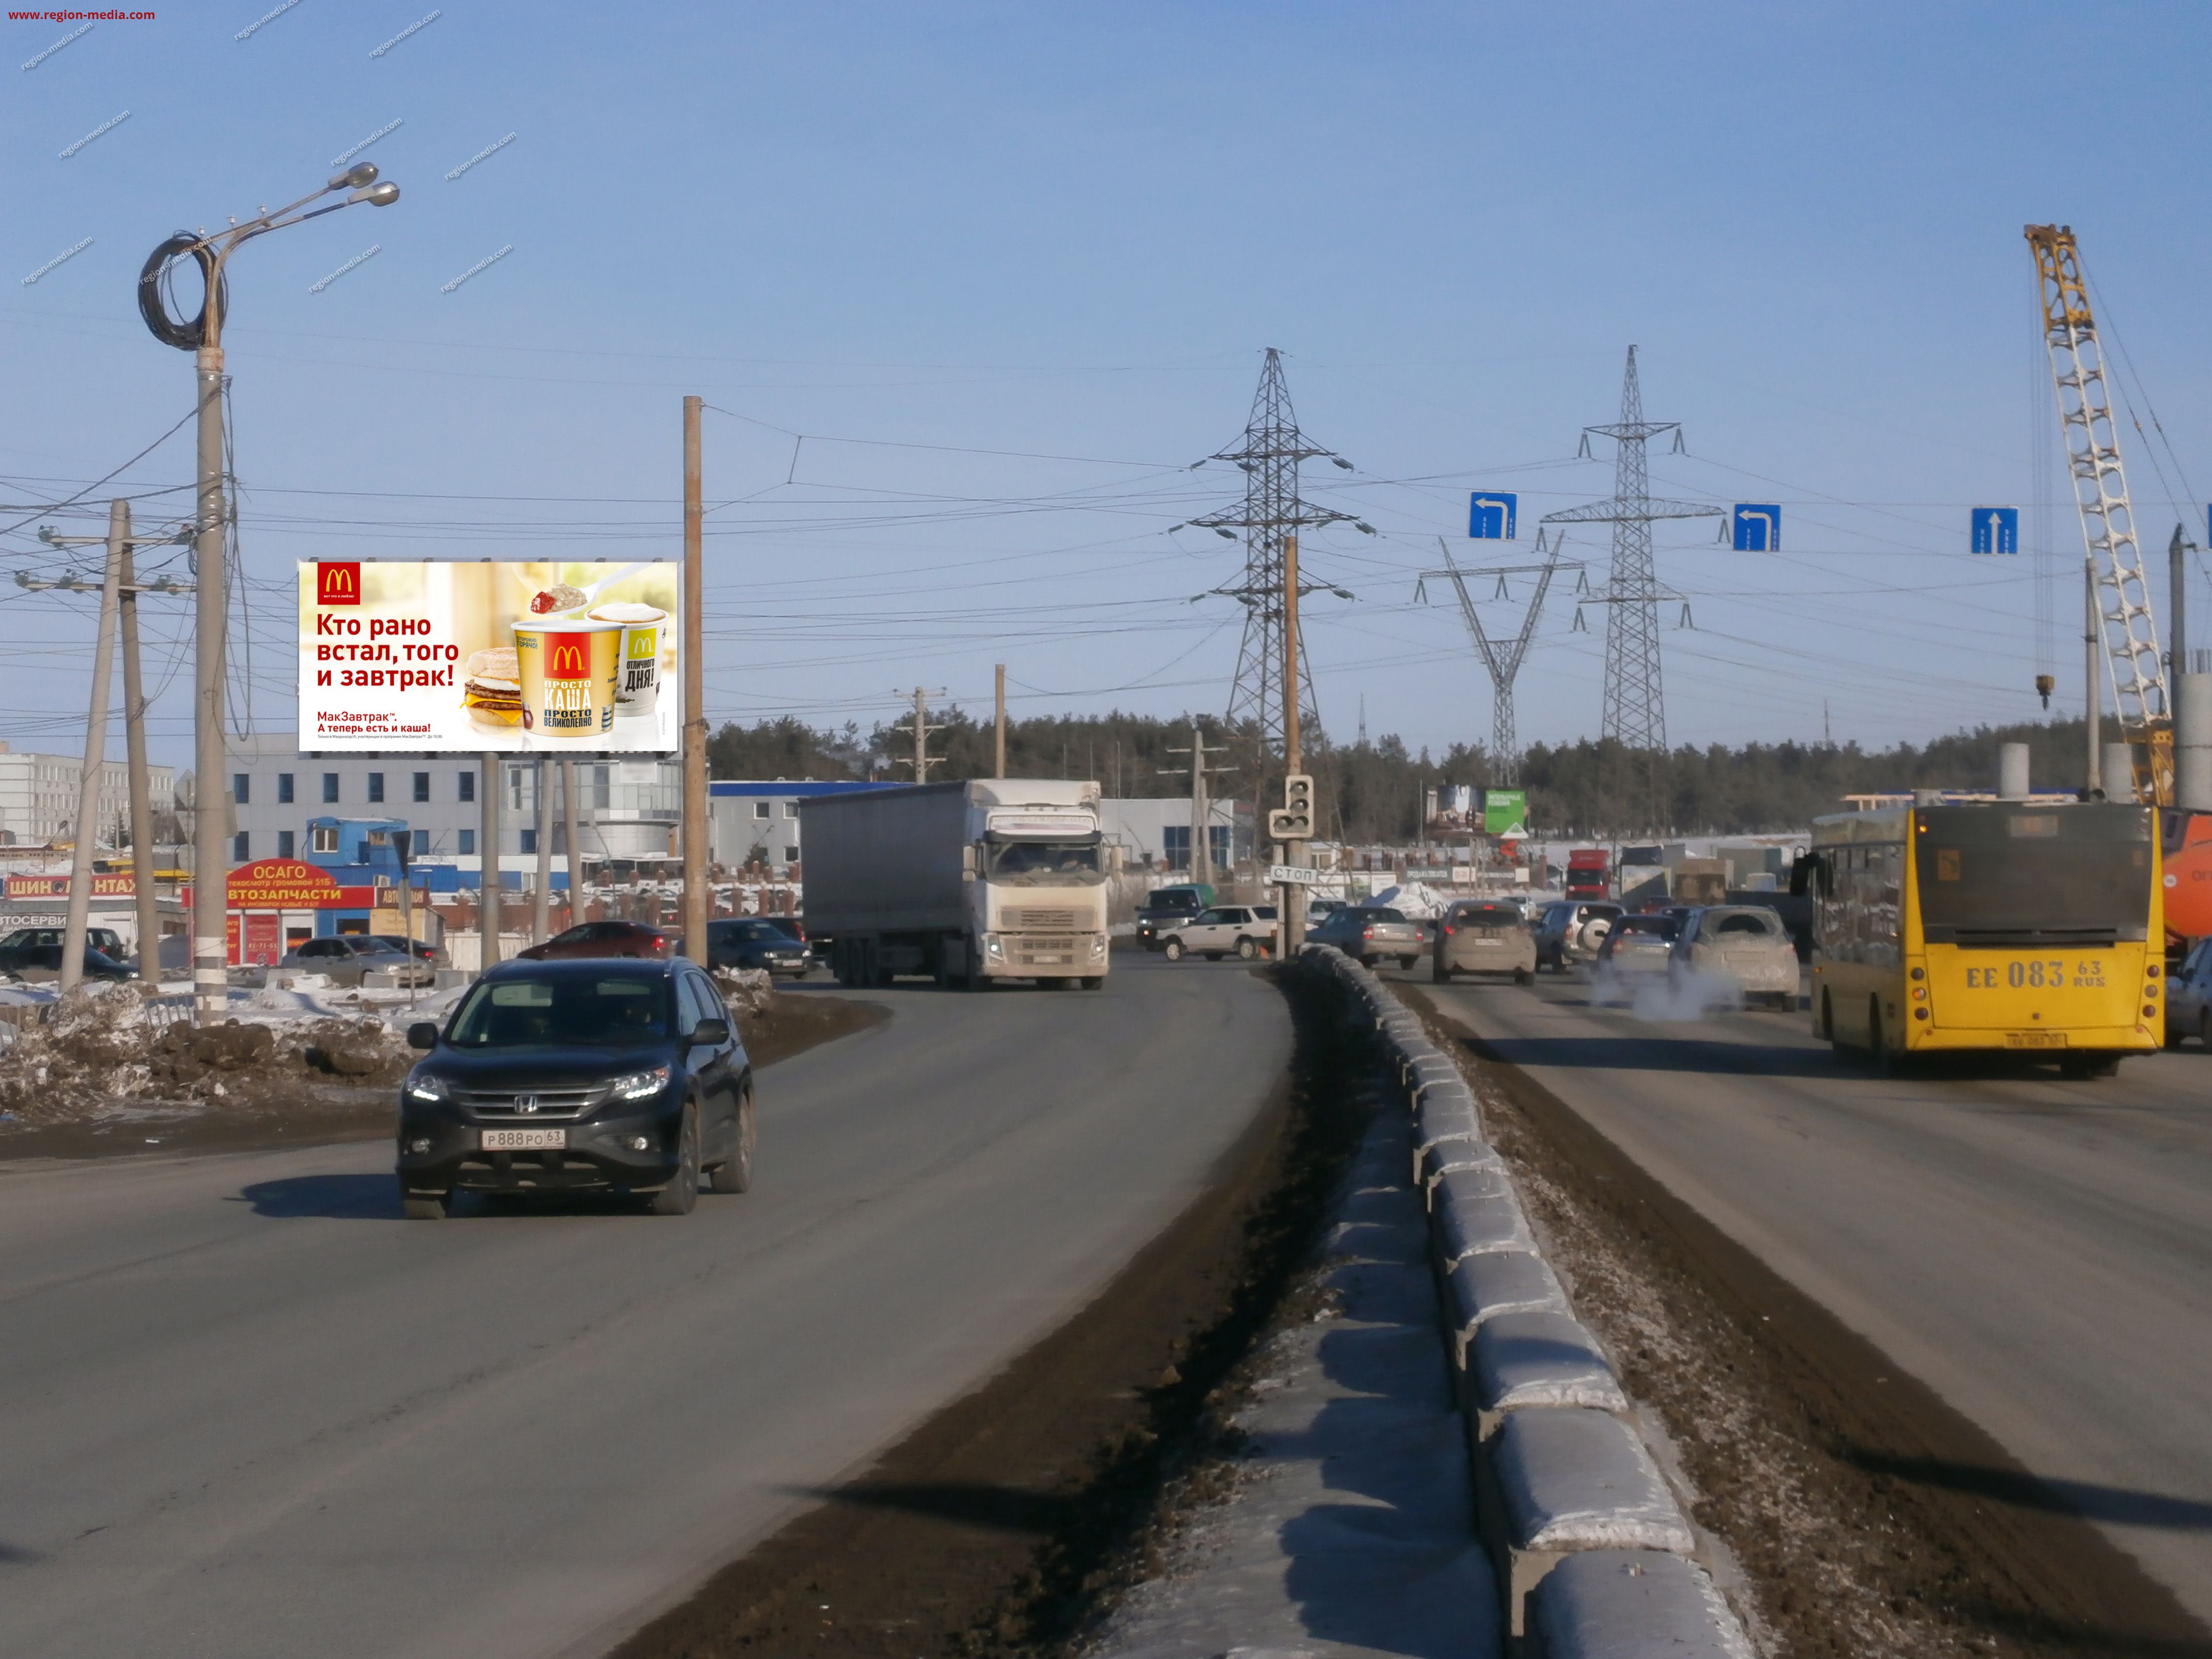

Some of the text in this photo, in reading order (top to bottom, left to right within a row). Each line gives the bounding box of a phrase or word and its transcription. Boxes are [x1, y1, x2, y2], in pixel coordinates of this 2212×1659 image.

[318, 614, 431, 640] Кто рано
[516, 640, 538, 649] ГОРЯЧО!
[317, 645, 459, 666] встал, того
[626, 658, 655, 670] ОТЛИЧНОГО
[317, 665, 454, 692] и завтрак!
[544, 680, 591, 689] ПРОСТО
[625, 667, 654, 692] ДНЯ!
[544, 688, 591, 711] КАША
[544, 709, 592, 718] ПРОСТО
[318, 723, 325, 732] А
[328, 726, 363, 734] теперь
[401, 723, 431, 732] каша!
[544, 717, 592, 728] ВЕЛИКОЛЕПНО
[253, 865, 306, 879] ОСАГО
[1274, 868, 1312, 881] СТОП
[228, 889, 342, 900] ВТОЗАПЧАСТИ
[2008, 960, 2064, 988] 083
[2077, 961, 2102, 975] 63
[2073, 977, 2106, 987] RUS
[546, 1131, 560, 1141] 63
